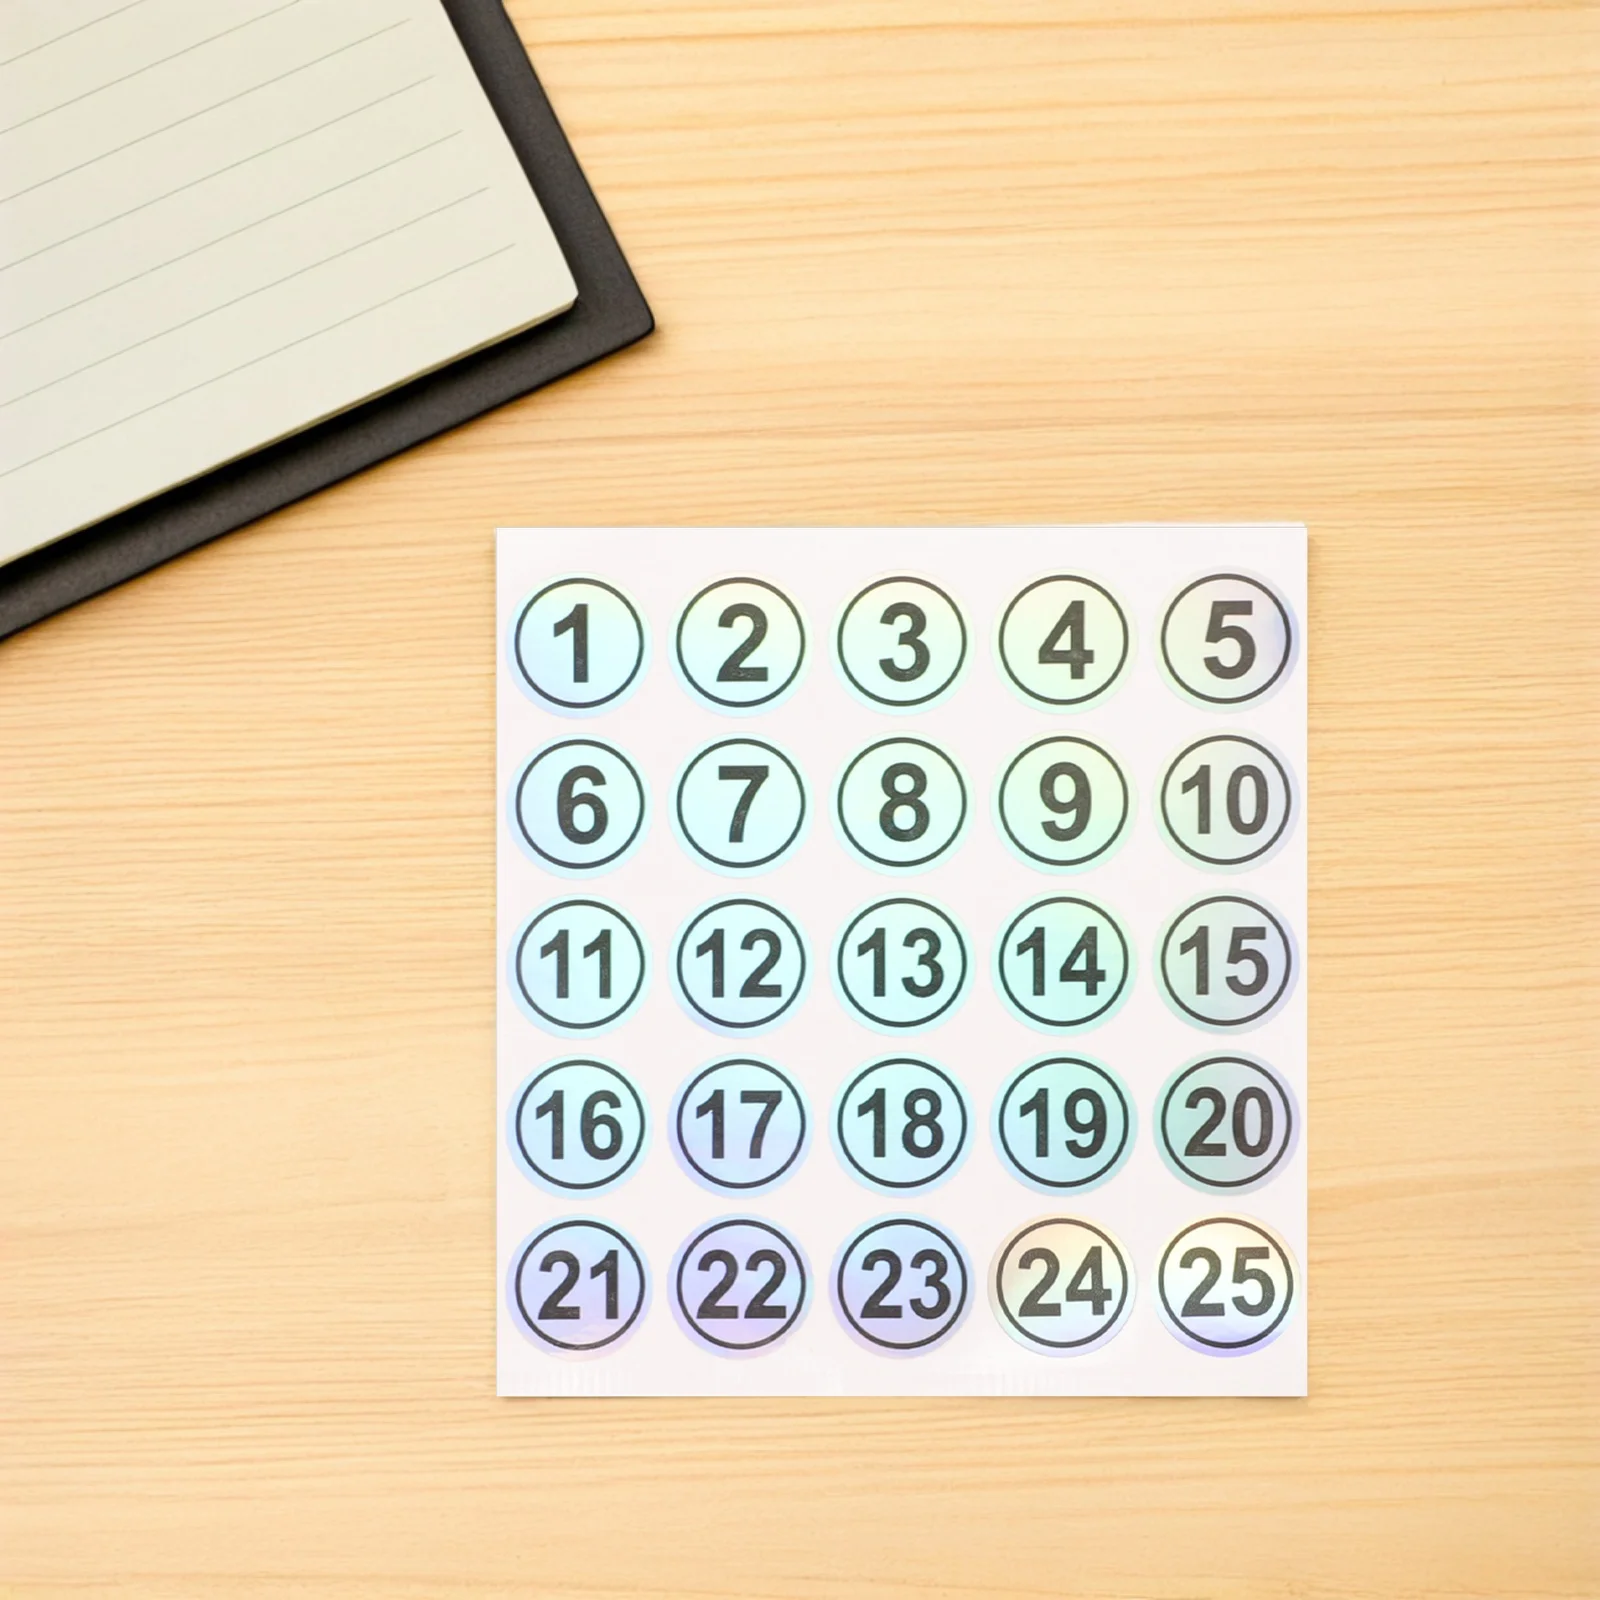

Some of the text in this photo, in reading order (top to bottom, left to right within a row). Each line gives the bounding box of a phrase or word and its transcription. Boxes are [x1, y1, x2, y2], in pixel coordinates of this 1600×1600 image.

[551, 603, 588, 682] 1
[716, 603, 768, 681] 2
[879, 602, 930, 681] 3
[1038, 600, 1094, 679] 4
[1203, 600, 1256, 679] 5
[557, 765, 608, 844] 6
[718, 765, 769, 842] 7
[879, 762, 930, 842] 8
[1039, 762, 1092, 841] 9
[1180, 764, 1269, 834] 10
[538, 929, 611, 998] 11
[694, 928, 782, 997] 12
[855, 927, 944, 997] 13
[1014, 926, 1106, 995] 14
[1178, 925, 1269, 995] 15
[534, 1090, 623, 1160] 16
[694, 1089, 782, 1158] 17
[855, 1087, 944, 1158] 18
[1017, 1087, 1107, 1158] 19
[1184, 1086, 1274, 1157] 20
[537, 1249, 619, 1319] 21
[696, 1249, 787, 1318] 22
[860, 1248, 951, 1319] 23
[1018, 1246, 1112, 1316] 24
[1180, 1246, 1275, 1316] 25
